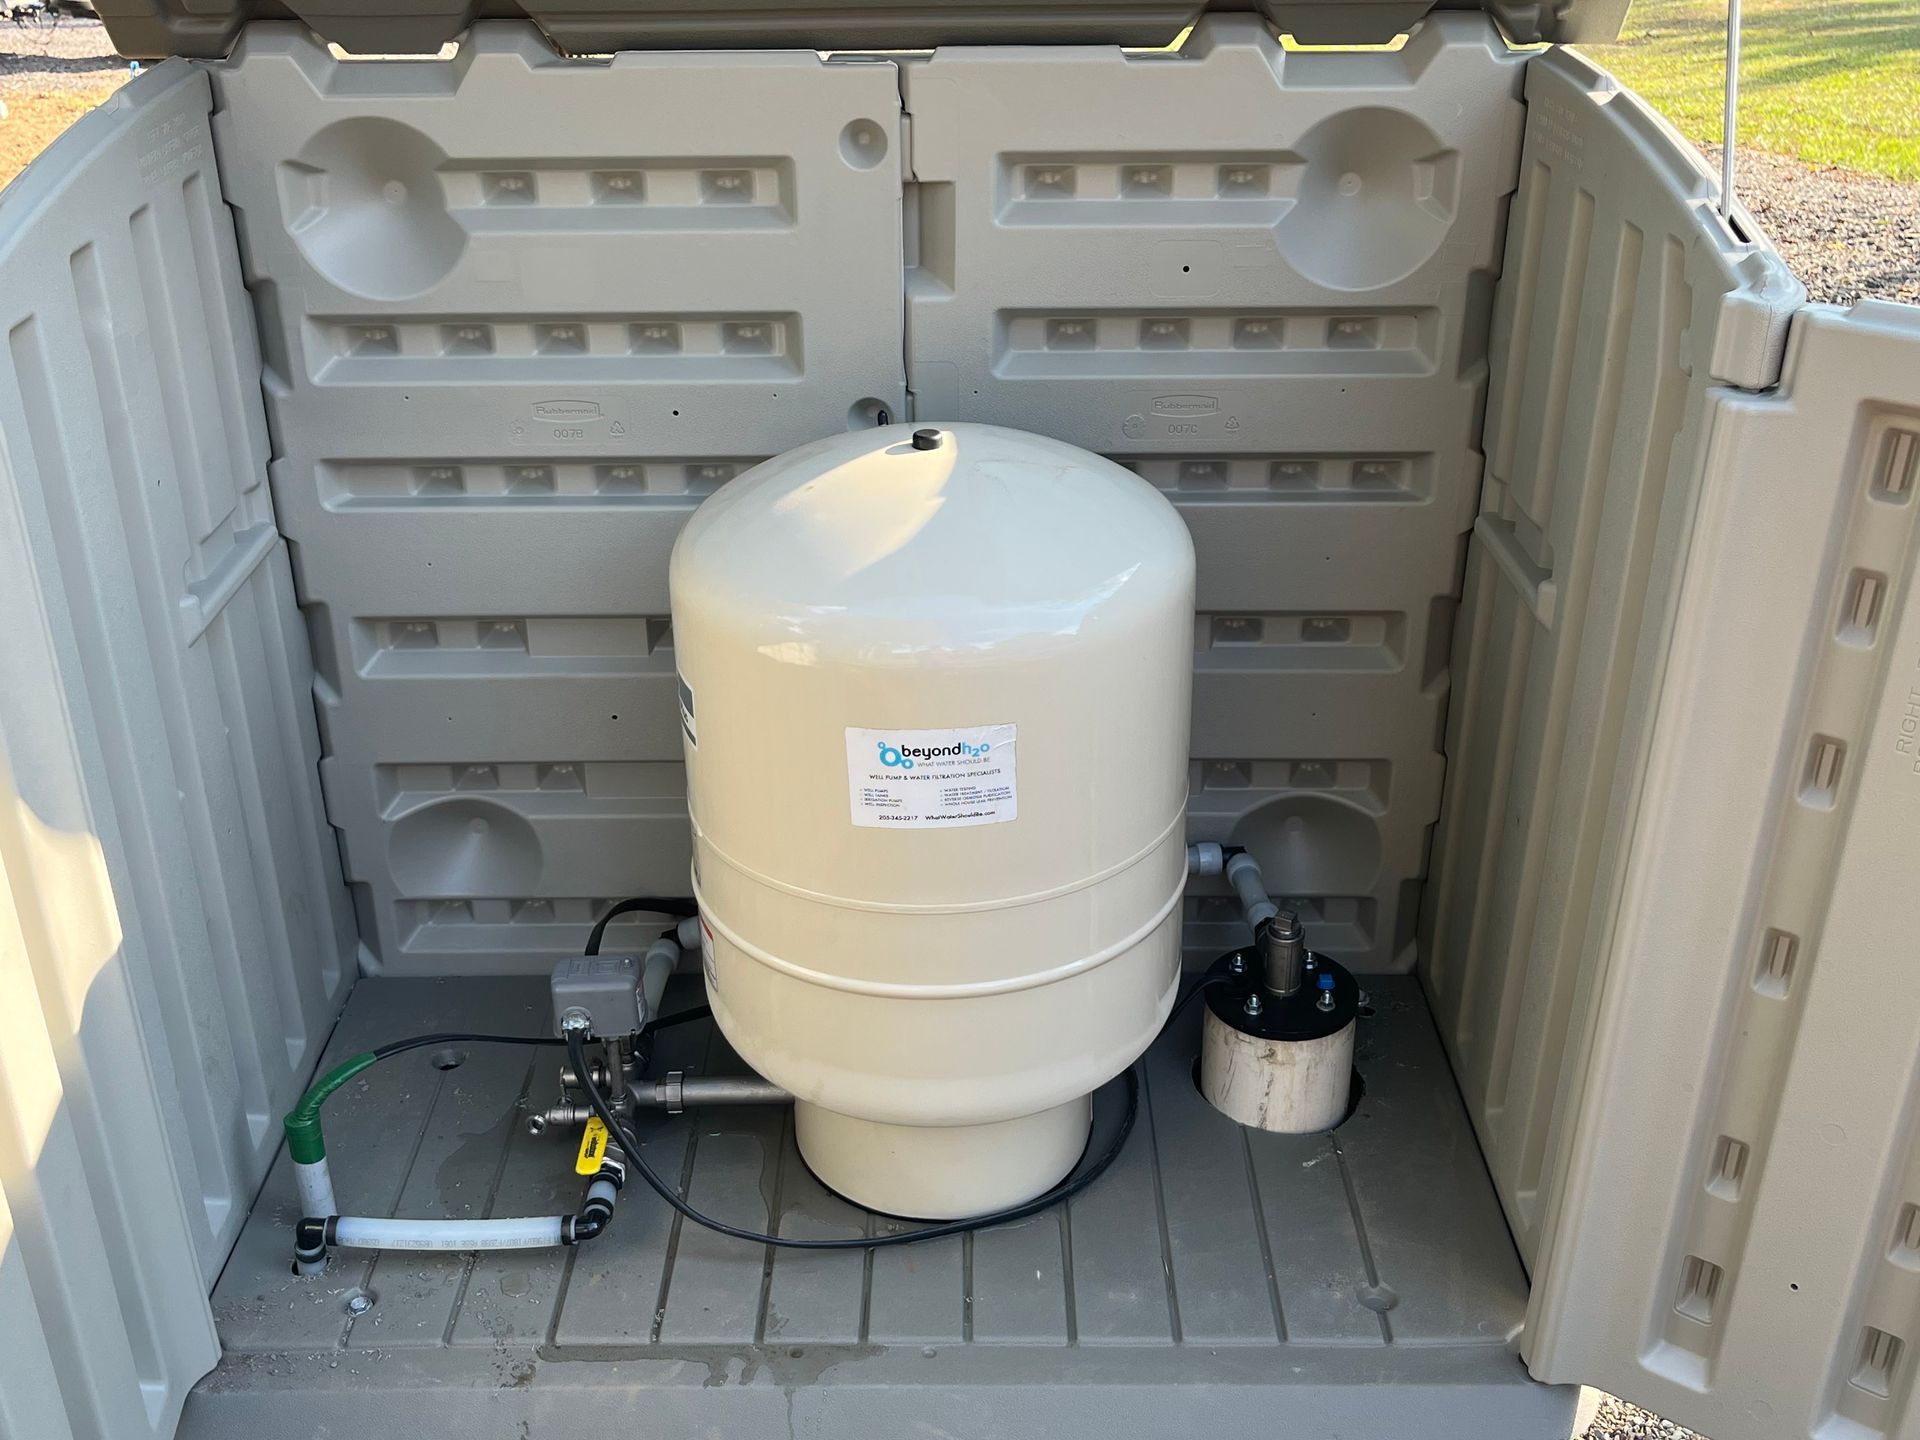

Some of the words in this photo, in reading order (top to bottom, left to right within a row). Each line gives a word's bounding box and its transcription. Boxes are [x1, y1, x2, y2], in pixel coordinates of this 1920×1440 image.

[1154, 400, 1215, 410] Rubbermaid
[535, 406, 598, 415] Rubbermaid
[1168, 424, 1199, 434] 007C
[1895, 686, 1920, 754] RIGHT
[957, 758, 981, 766] SHOULD
[932, 772, 966, 780] FILTRATION
[967, 768, 1001, 778] SPECIALISTS
